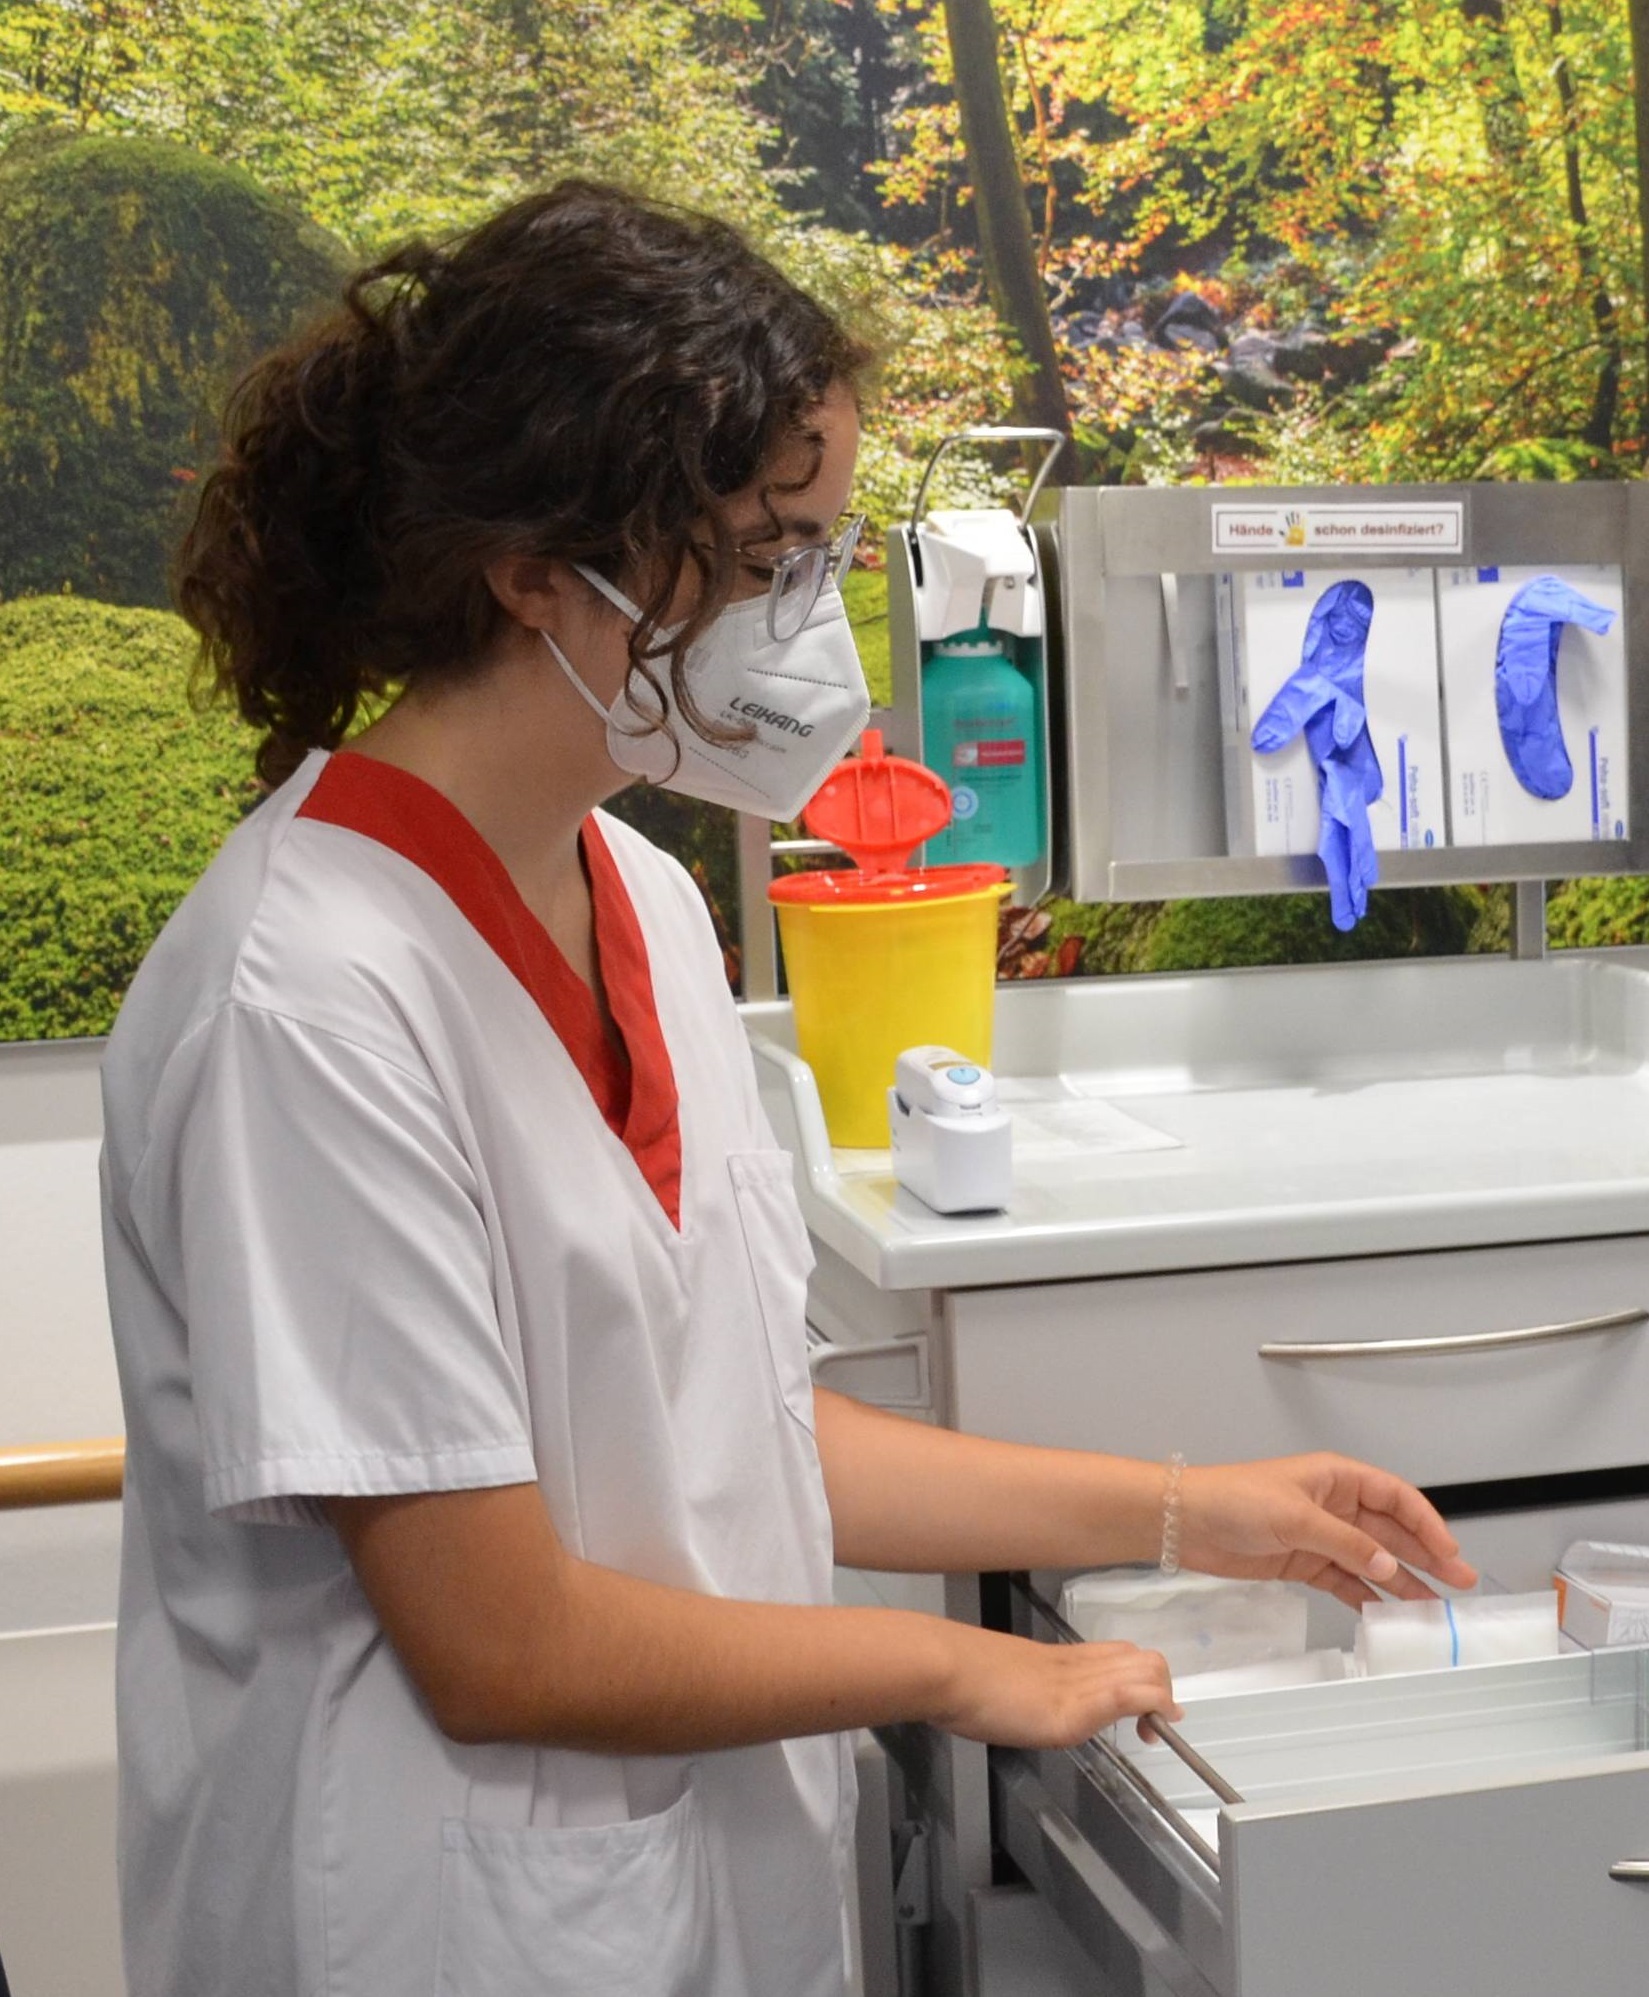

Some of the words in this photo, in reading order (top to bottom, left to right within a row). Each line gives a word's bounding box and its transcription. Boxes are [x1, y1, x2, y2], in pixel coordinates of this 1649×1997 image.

[1229, 523, 1273, 536] Hände
[1314, 524, 1356, 536] schon
[1360, 524, 1444, 536] desinfiziert?
